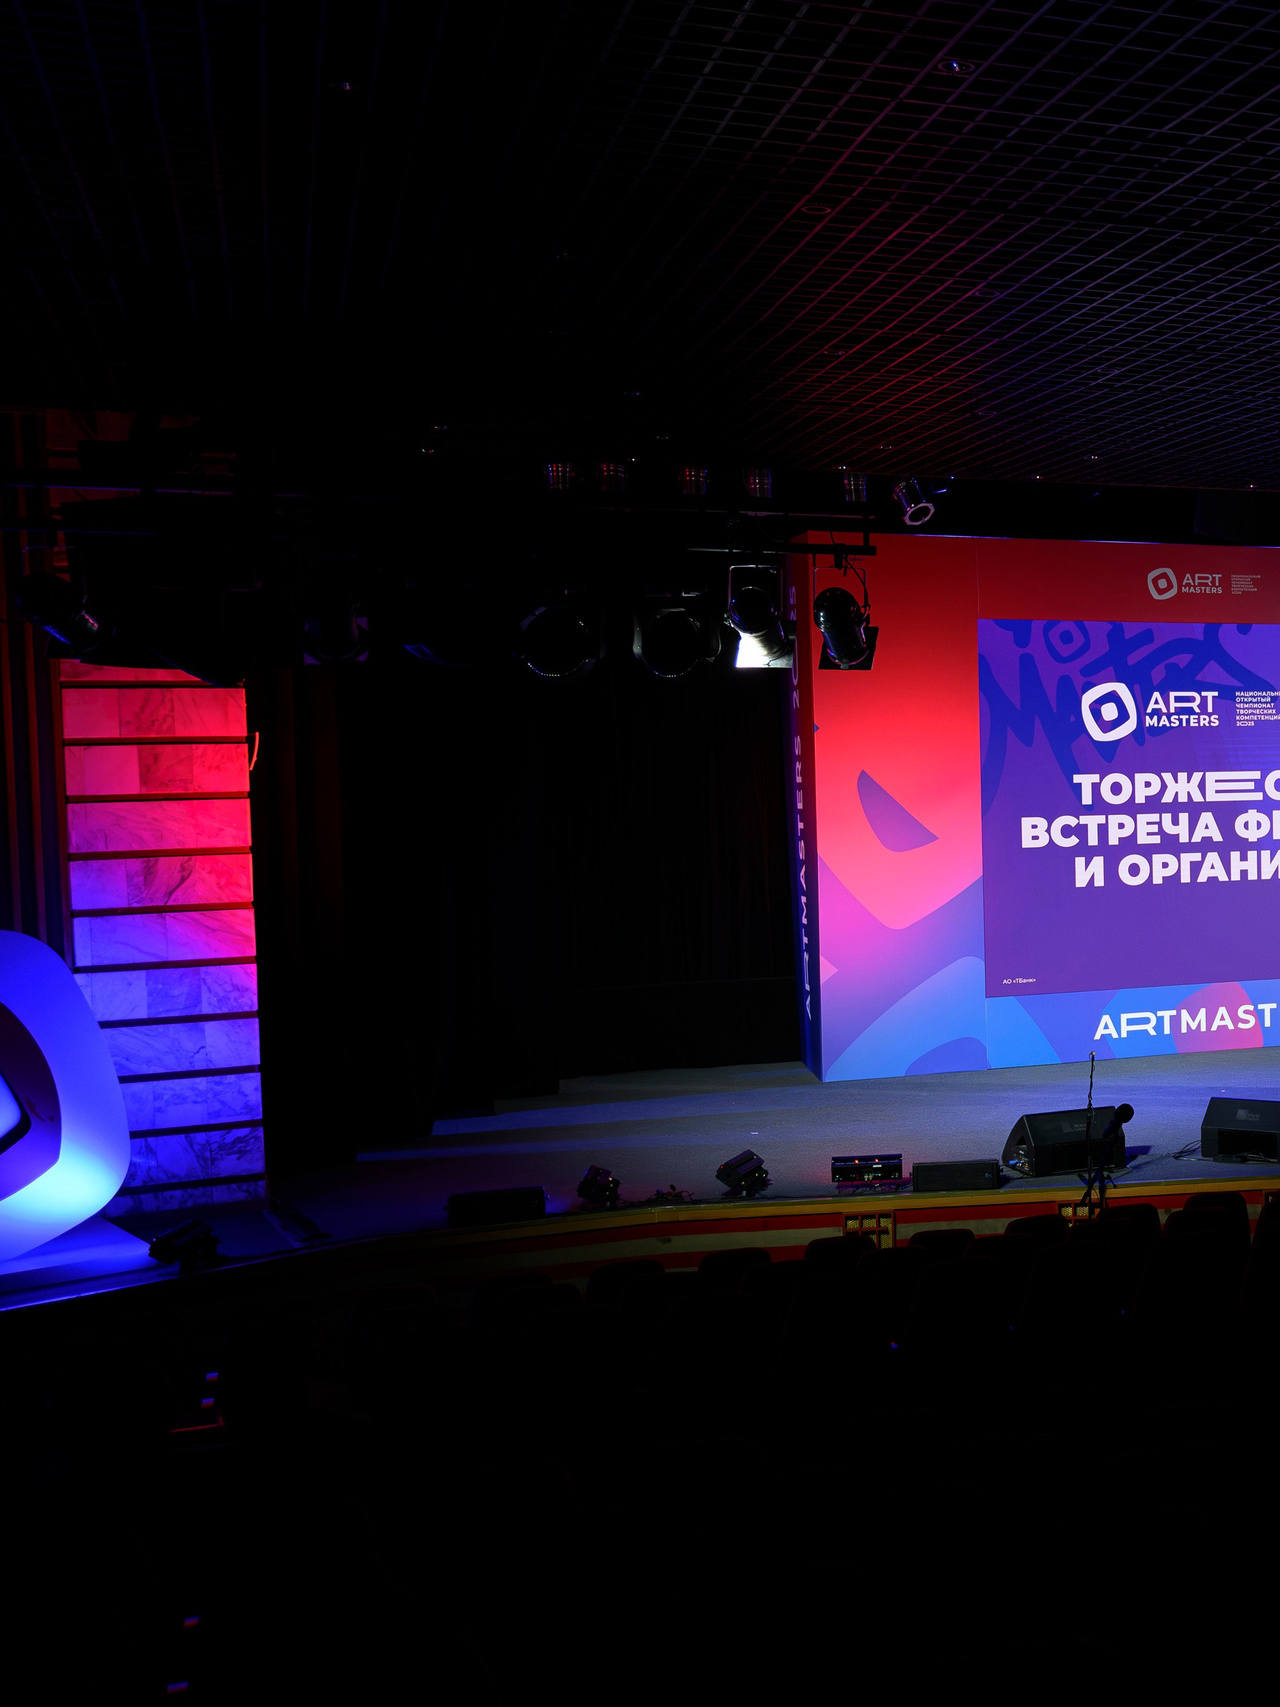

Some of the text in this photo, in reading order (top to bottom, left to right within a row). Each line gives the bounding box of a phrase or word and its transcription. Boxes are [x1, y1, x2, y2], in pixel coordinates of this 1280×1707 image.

[1182, 573, 1223, 586] ART
[1182, 586, 1223, 594] MASTERS
[1145, 691, 1219, 714] ART
[1145, 714, 1220, 728] MASTERS
[1021, 811, 1223, 849] ВСТРЕЧА
[794, 734, 812, 1021] ARTMASTERS
[1075, 856, 1105, 888] И
